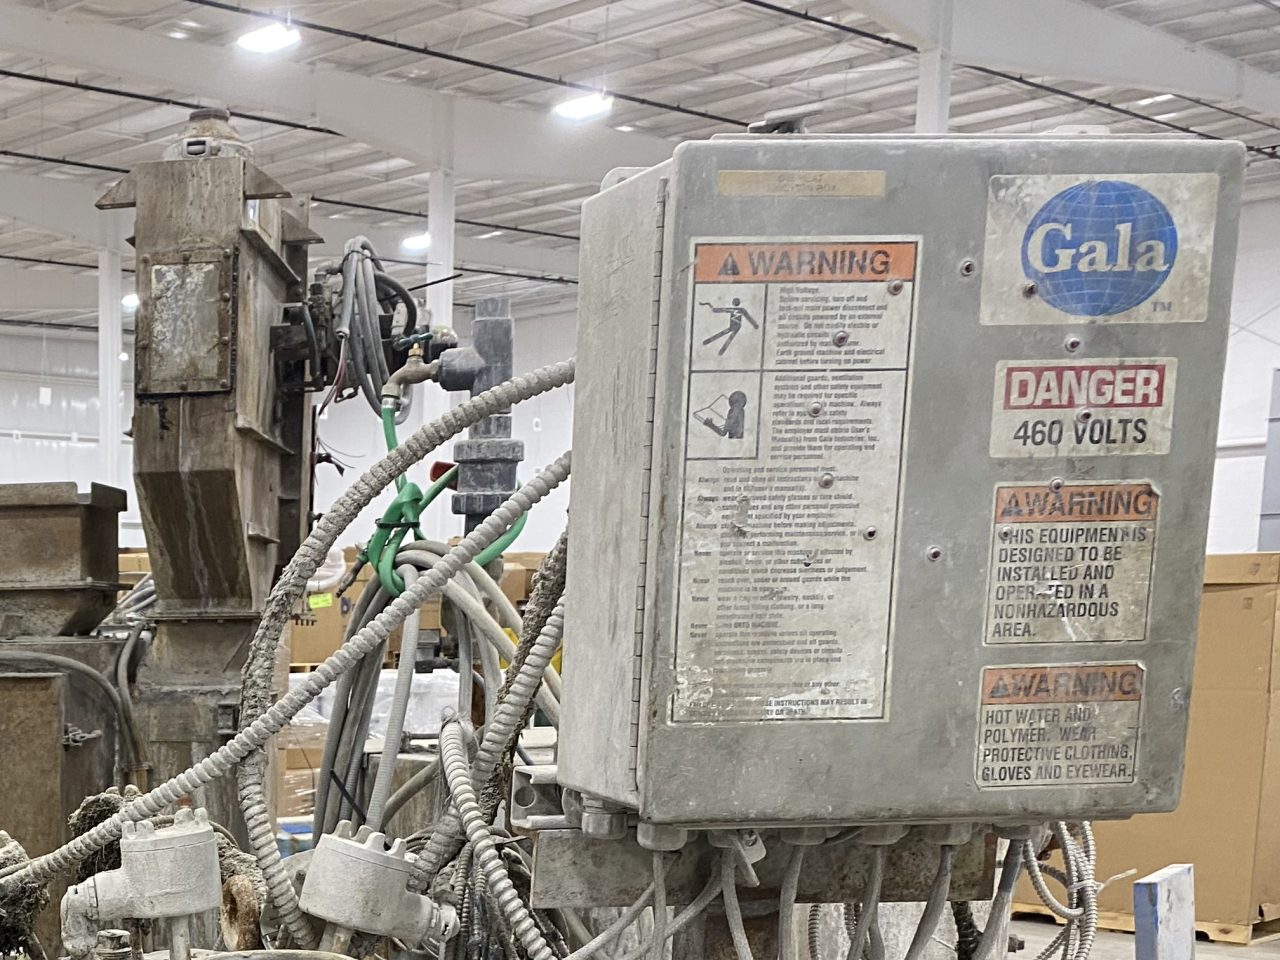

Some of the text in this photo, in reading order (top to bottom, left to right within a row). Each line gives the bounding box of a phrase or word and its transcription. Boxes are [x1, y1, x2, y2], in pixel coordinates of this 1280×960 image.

[1027, 223, 1169, 273] Gala
[748, 250, 890, 275] WARNING
[1010, 369, 1160, 406] DANGER
[1014, 418, 1147, 445] 460 VOLTS
[1026, 491, 1152, 515] WARNING
[1133, 528, 1146, 541] IS
[999, 546, 1122, 562] DESIGNED TO BE
[998, 565, 1114, 581] INSTALLED AND
[1080, 585, 1094, 598] IN
[1099, 584, 1108, 598] A
[994, 602, 1118, 619] NONHAZARDOUS
[992, 623, 1036, 637] AREA.
[986, 708, 1090, 724] HOT WATER AND
[985, 727, 1096, 743] POLYMER. WEAR
[983, 745, 1133, 762] PROTECTIVE CLOTHING,
[982, 764, 1131, 781] GLOVES AND EYEWEAR.
